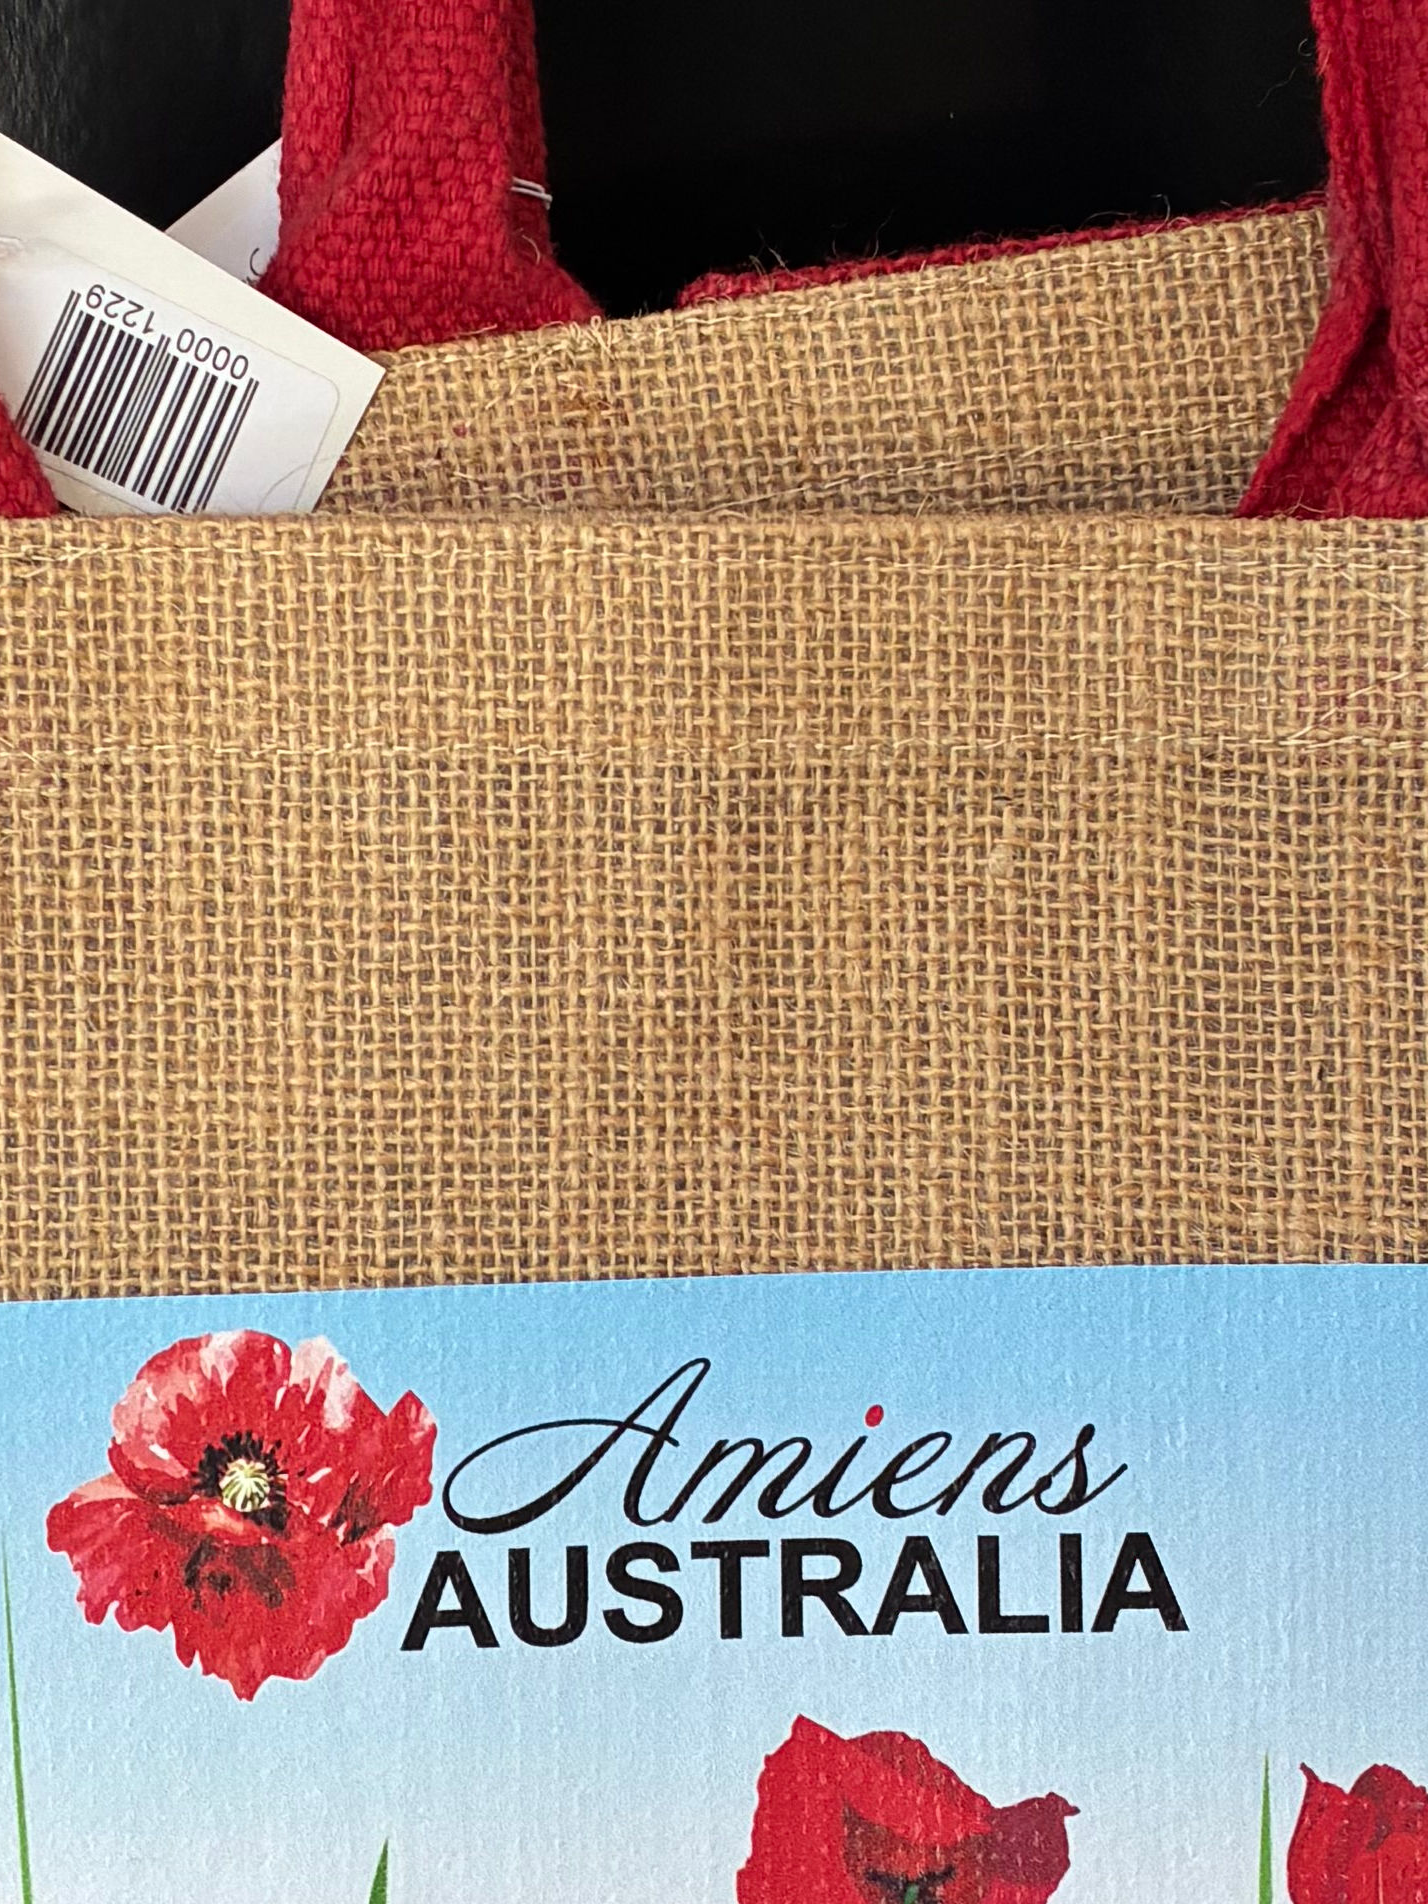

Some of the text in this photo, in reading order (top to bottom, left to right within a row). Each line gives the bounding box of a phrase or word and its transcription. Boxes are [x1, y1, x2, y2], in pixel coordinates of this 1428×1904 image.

[86, 284, 249, 380] 0000 1229
[442, 1358, 1130, 1533] Amiens
[401, 1532, 1189, 1652] AUSTRALIA
